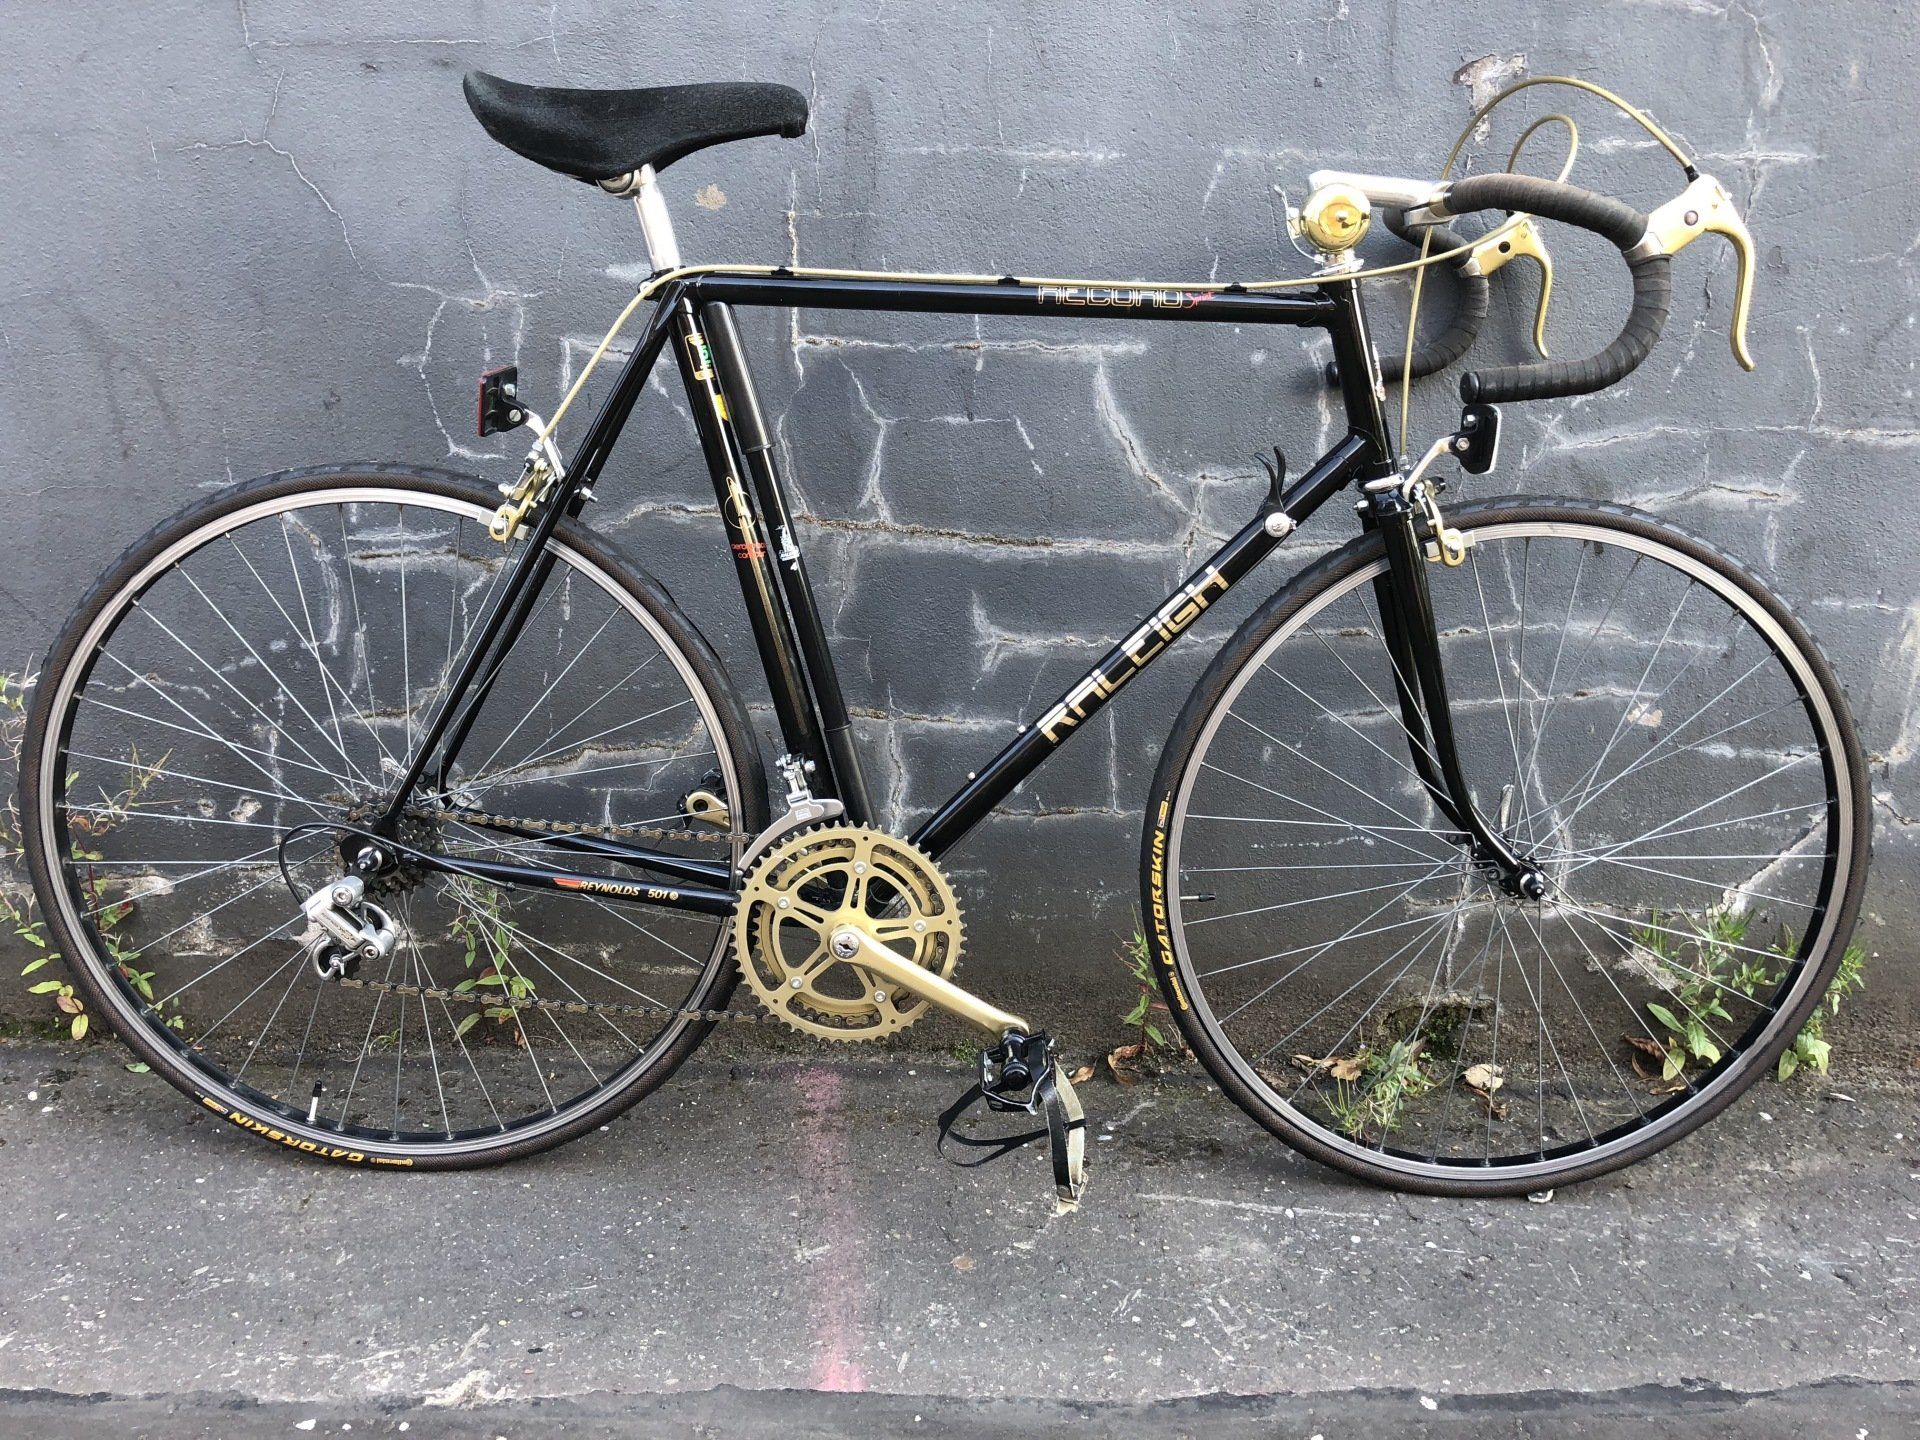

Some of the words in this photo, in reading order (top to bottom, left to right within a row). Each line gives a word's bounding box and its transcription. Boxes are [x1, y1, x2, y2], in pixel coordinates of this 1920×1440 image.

[1038, 285, 1183, 309] RECORD
[1036, 565, 1229, 744] RALEIGH
[579, 880, 641, 897] REYNOLDS
[647, 888, 669, 900] 501
[1151, 829, 1175, 966] GATORSKIN
[228, 1111, 365, 1163] GATORSKIN
